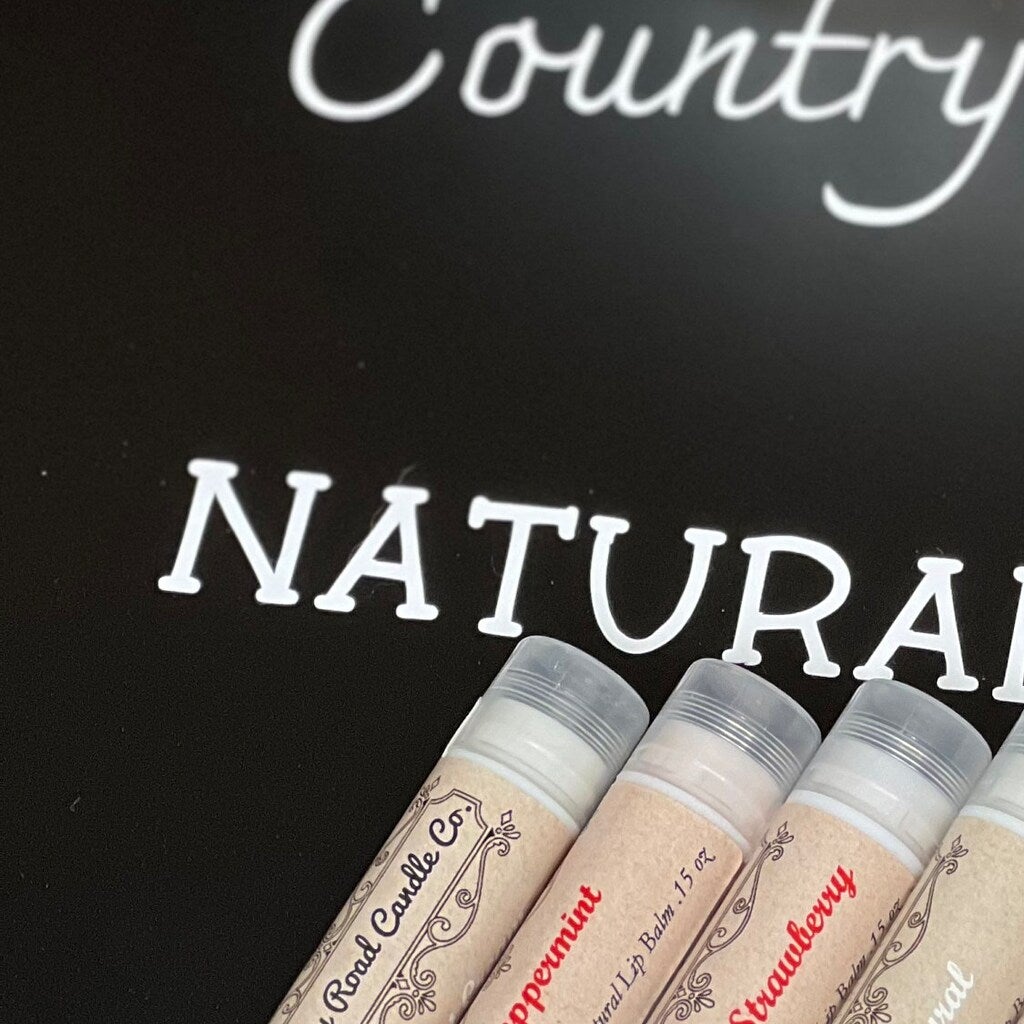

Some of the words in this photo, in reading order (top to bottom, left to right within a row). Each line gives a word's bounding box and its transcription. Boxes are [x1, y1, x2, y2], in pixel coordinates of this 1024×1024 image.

[322, 933, 382, 1014] Road
[371, 851, 440, 939] Candle
[428, 805, 473, 848] Co.
[501, 883, 602, 1024] ppermint
[615, 953, 647, 991] Lip
[637, 904, 675, 954] Balm
[673, 867, 693, 906] .15
[694, 847, 716, 872] oz
[927, 959, 975, 1024] ral
